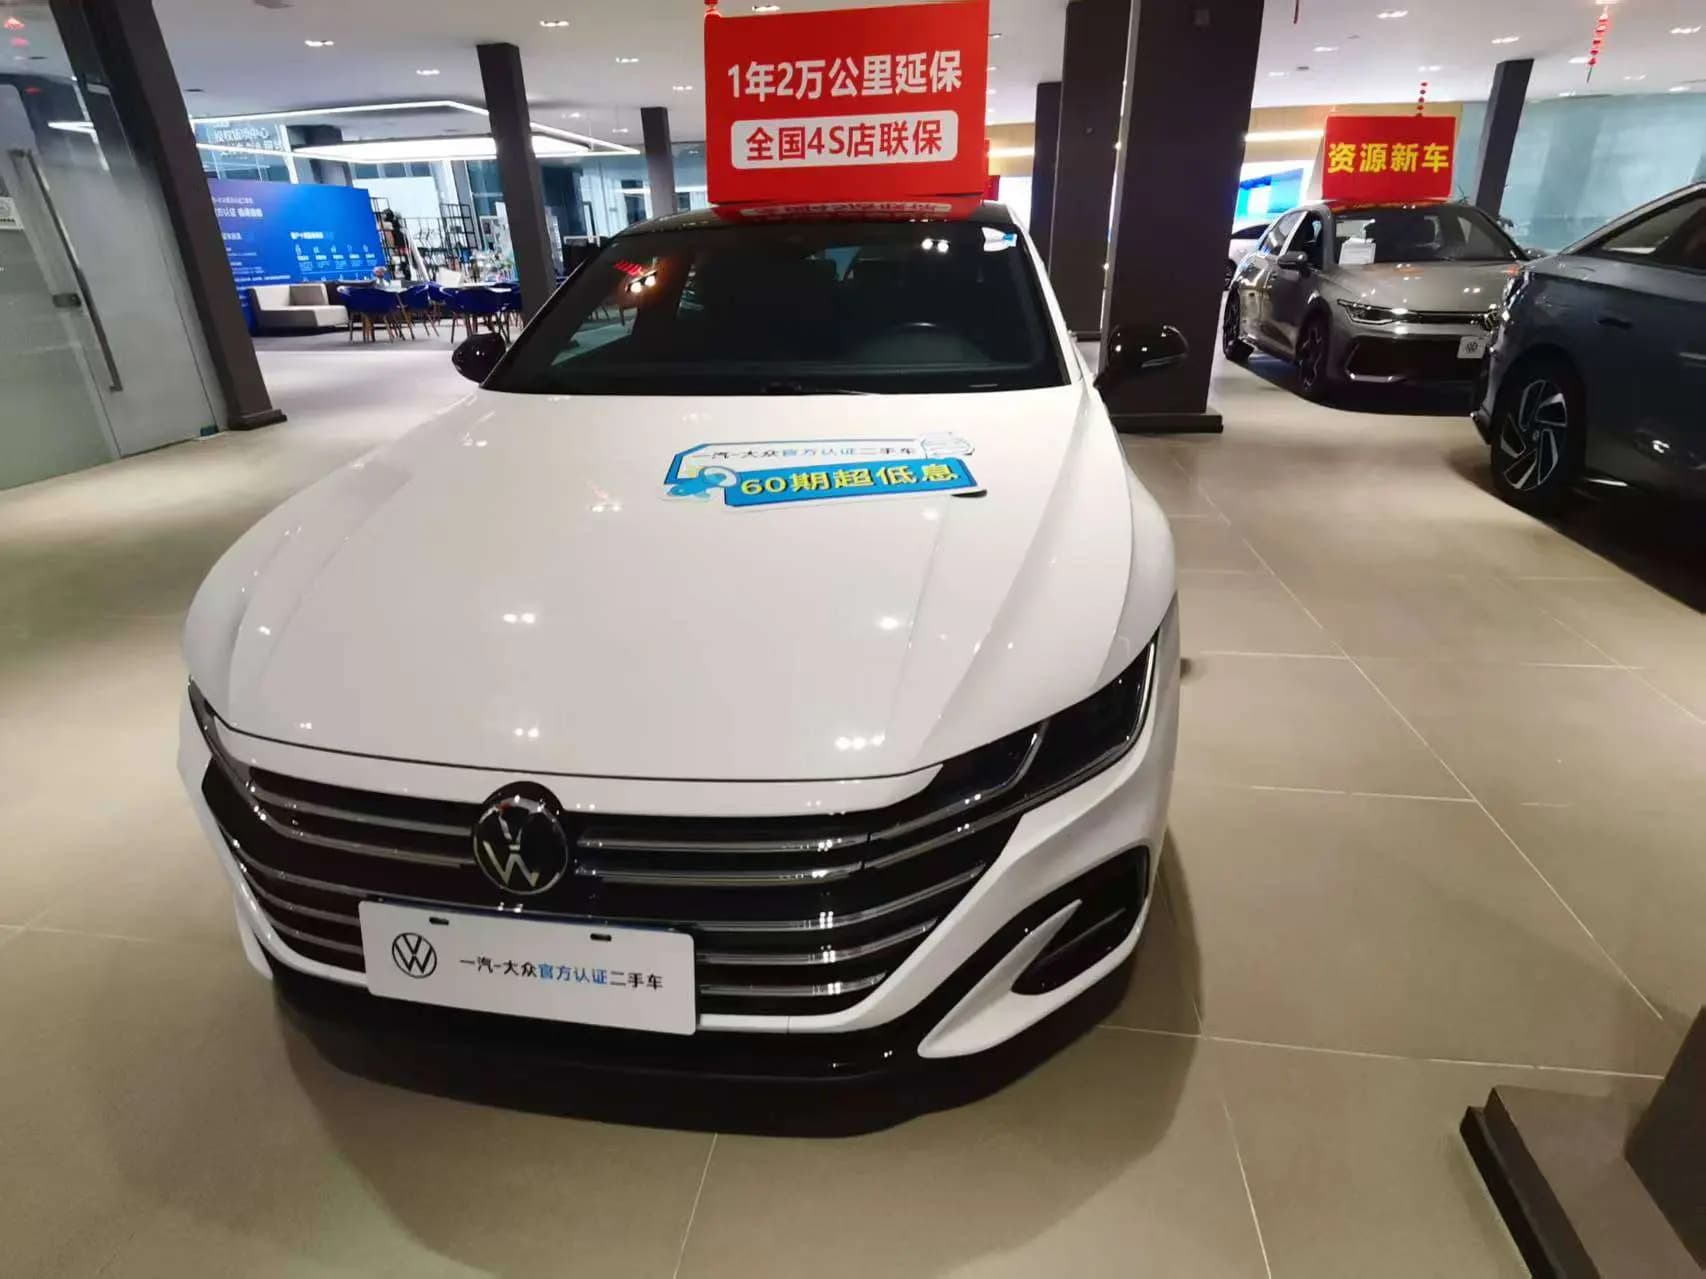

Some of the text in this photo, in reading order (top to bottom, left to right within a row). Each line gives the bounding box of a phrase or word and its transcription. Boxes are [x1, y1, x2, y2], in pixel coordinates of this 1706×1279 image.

[728, 50, 962, 102] 1年2万公里延保
[747, 119, 942, 161] 全国4S店联保
[1328, 142, 1449, 173] 资源新车
[741, 464, 960, 495] 60期超低息
[460, 955, 663, 990] 一汽-大众官方认证二手车
